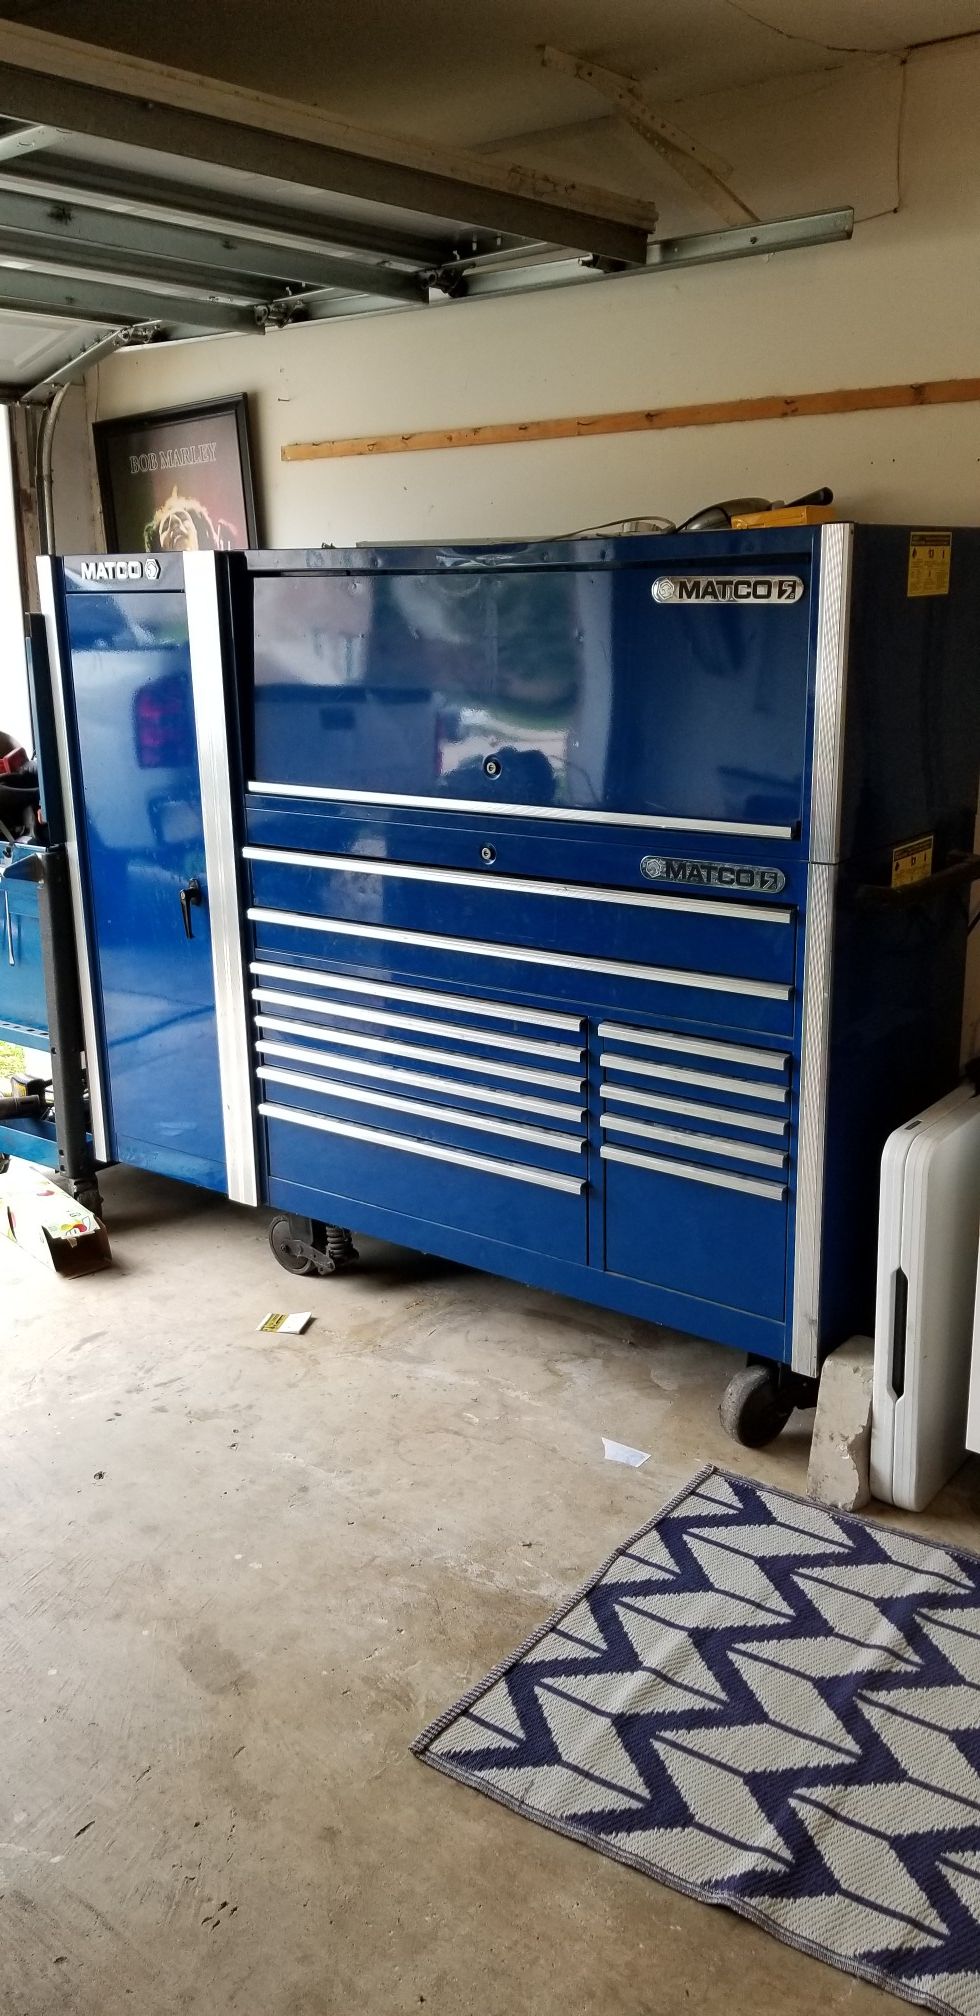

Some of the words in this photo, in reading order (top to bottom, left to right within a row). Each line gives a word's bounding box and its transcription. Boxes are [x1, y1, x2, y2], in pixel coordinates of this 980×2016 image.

[130, 453, 158, 474] BOB
[159, 442, 217, 470] MARLEY
[81, 561, 142, 580] MATCO
[679, 580, 773, 600] MATCO
[666, 861, 755, 887] MATCO
